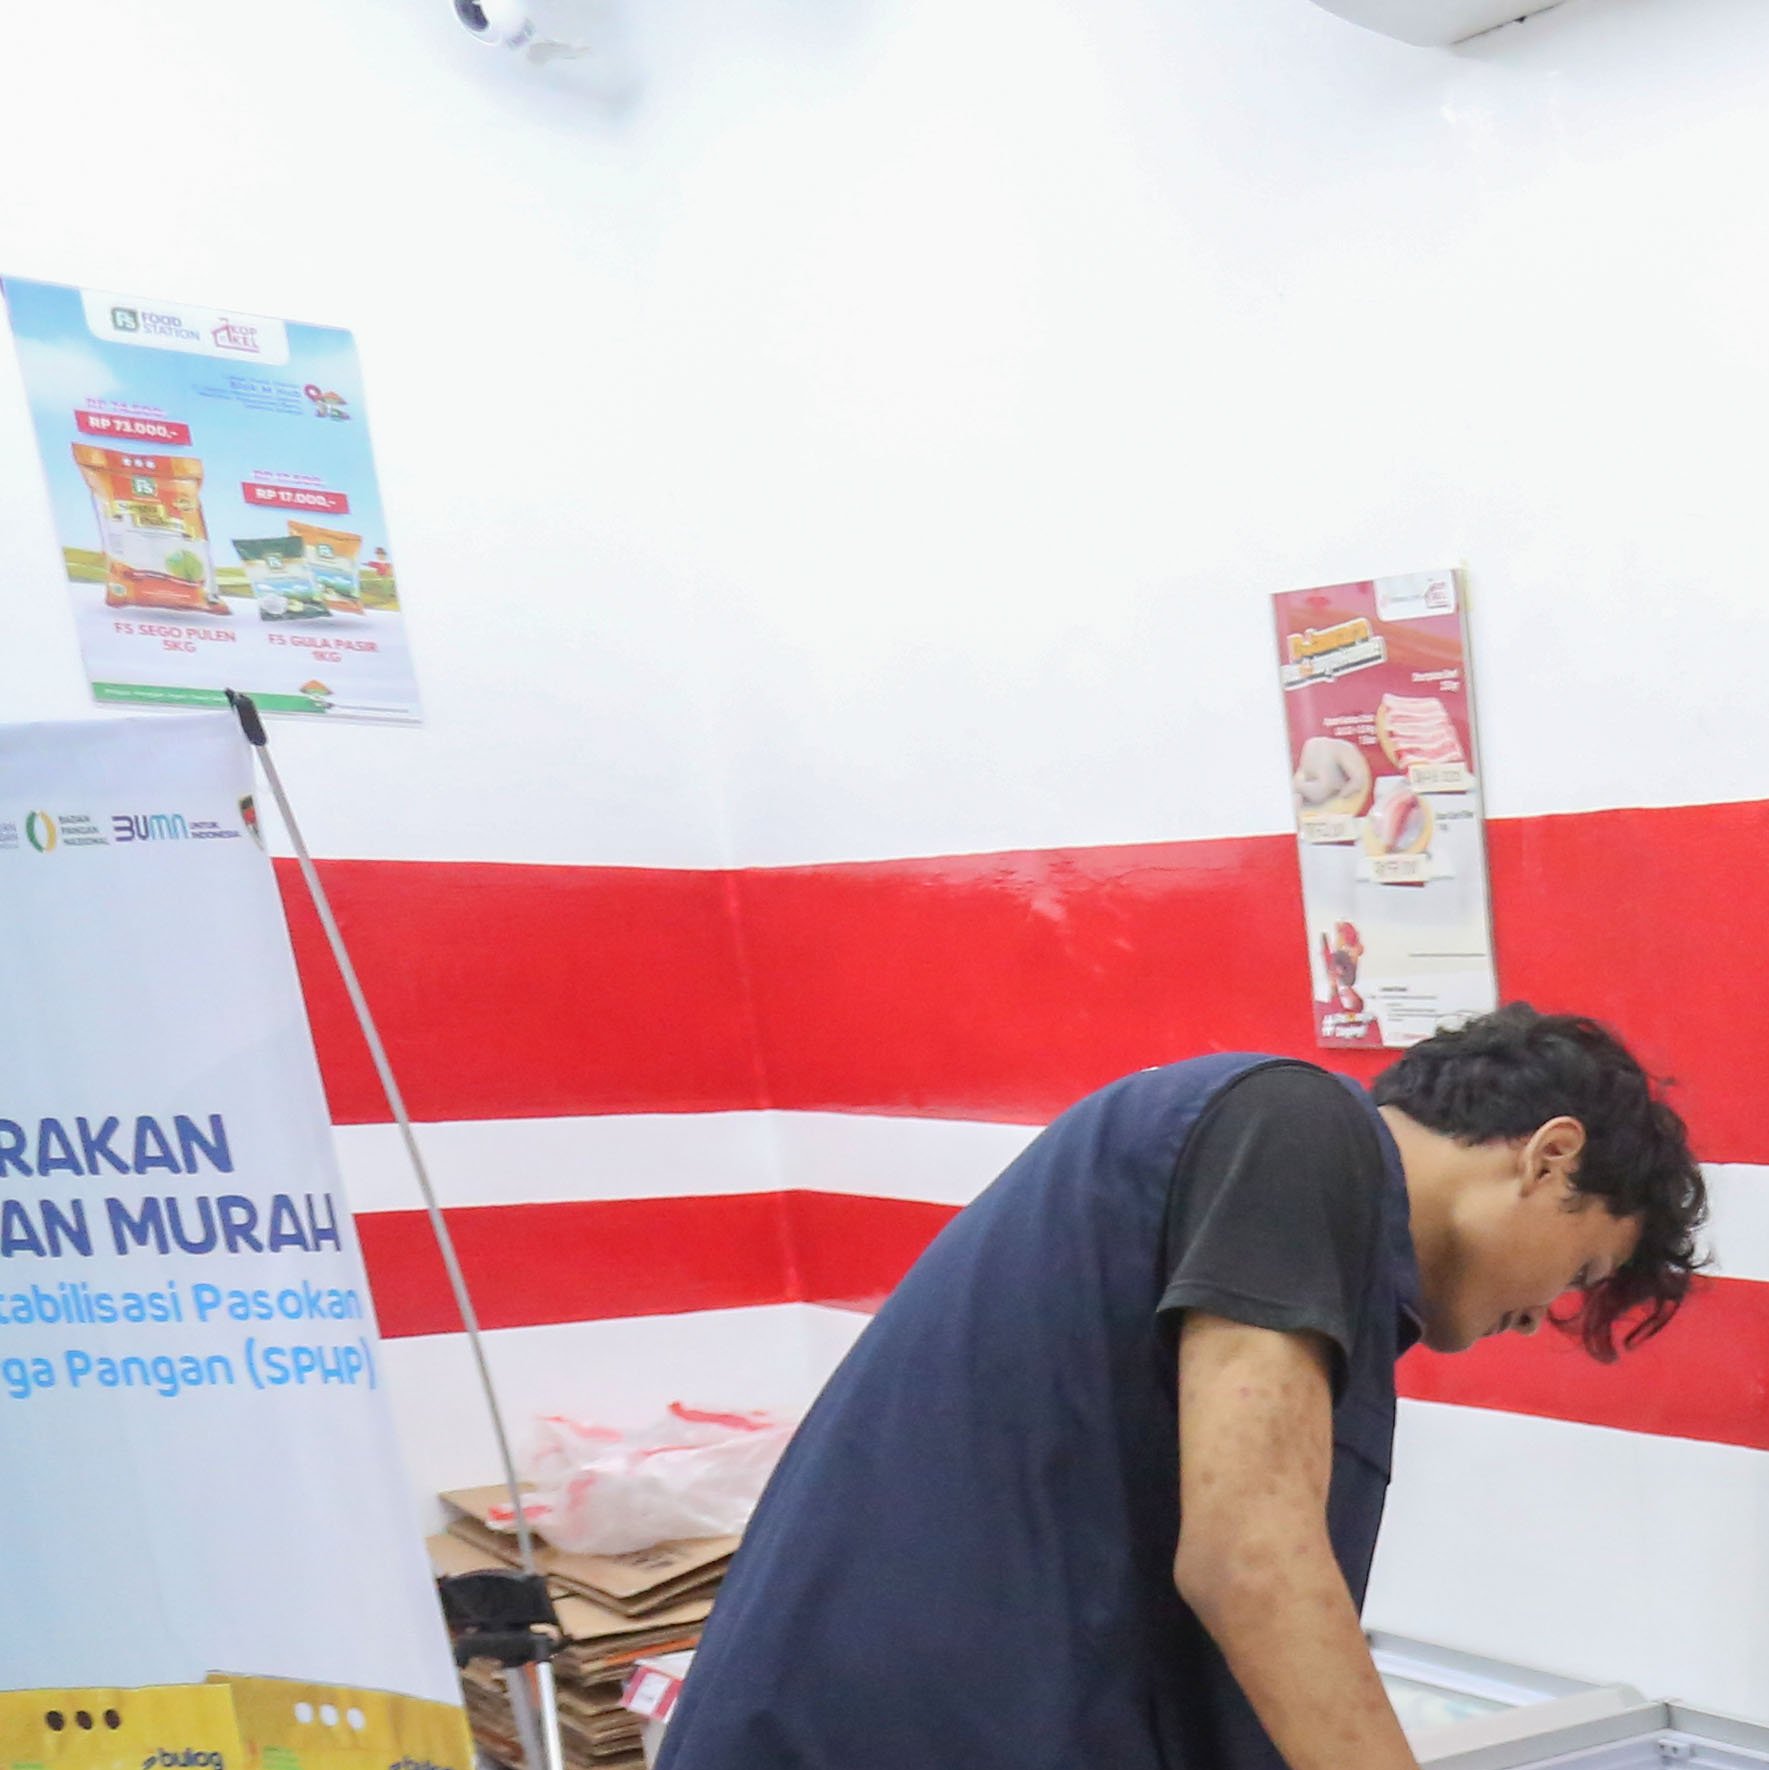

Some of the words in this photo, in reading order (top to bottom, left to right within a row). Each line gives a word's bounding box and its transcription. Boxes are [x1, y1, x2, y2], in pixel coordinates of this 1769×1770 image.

[142, 312, 182, 328] FOOD
[143, 324, 200, 342] STATION
[88, 415, 111, 430] RP
[255, 488, 276, 500] RP
[114, 623, 135, 634] FS
[139, 625, 181, 639] SEGO
[186, 628, 236, 642] PULEN
[163, 640, 196, 652] 5KG
[268, 634, 287, 645] FS
[291, 635, 330, 649] GULA
[334, 639, 378, 652] PASIR
[107, 1194, 342, 1257] MURAH
[193, 1282, 364, 1322] Pasokan
[3, 1355, 55, 1399] ga
[65, 1350, 234, 1399] Pangan
[245, 1338, 378, 1391] (SPHP)
